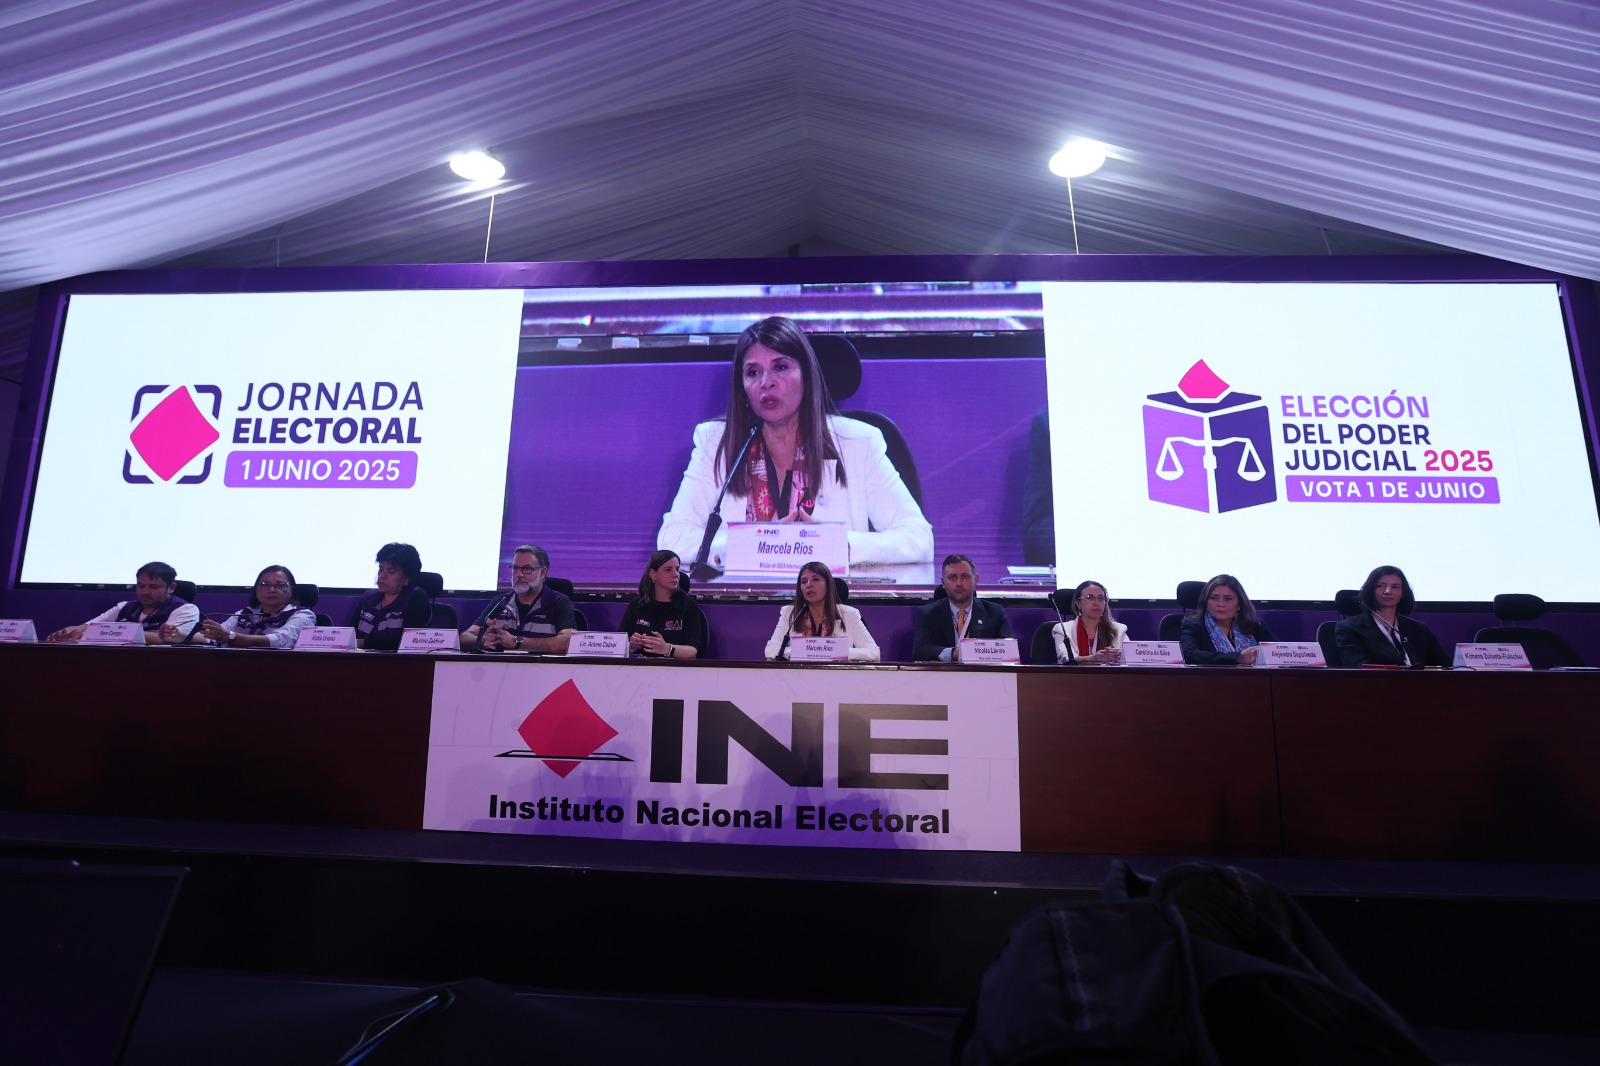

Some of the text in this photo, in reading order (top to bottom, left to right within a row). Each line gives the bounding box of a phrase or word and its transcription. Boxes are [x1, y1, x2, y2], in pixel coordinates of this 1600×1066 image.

[237, 381, 423, 411] JORNADA
[1281, 389, 1430, 418] ELECCIÓN
[232, 417, 422, 444] ELECTORAL
[1283, 423, 1431, 446] DEL PODER
[241, 459, 401, 481] 1 JUNIO 2025
[1285, 449, 1494, 472] JUDICIAL 2025
[1300, 481, 1485, 499] VOTA 1 DE JUNIO
[757, 541, 792, 554] Marcela
[650, 699, 949, 790] INE
[488, 794, 950, 834] Instituto Nacional Electoral
